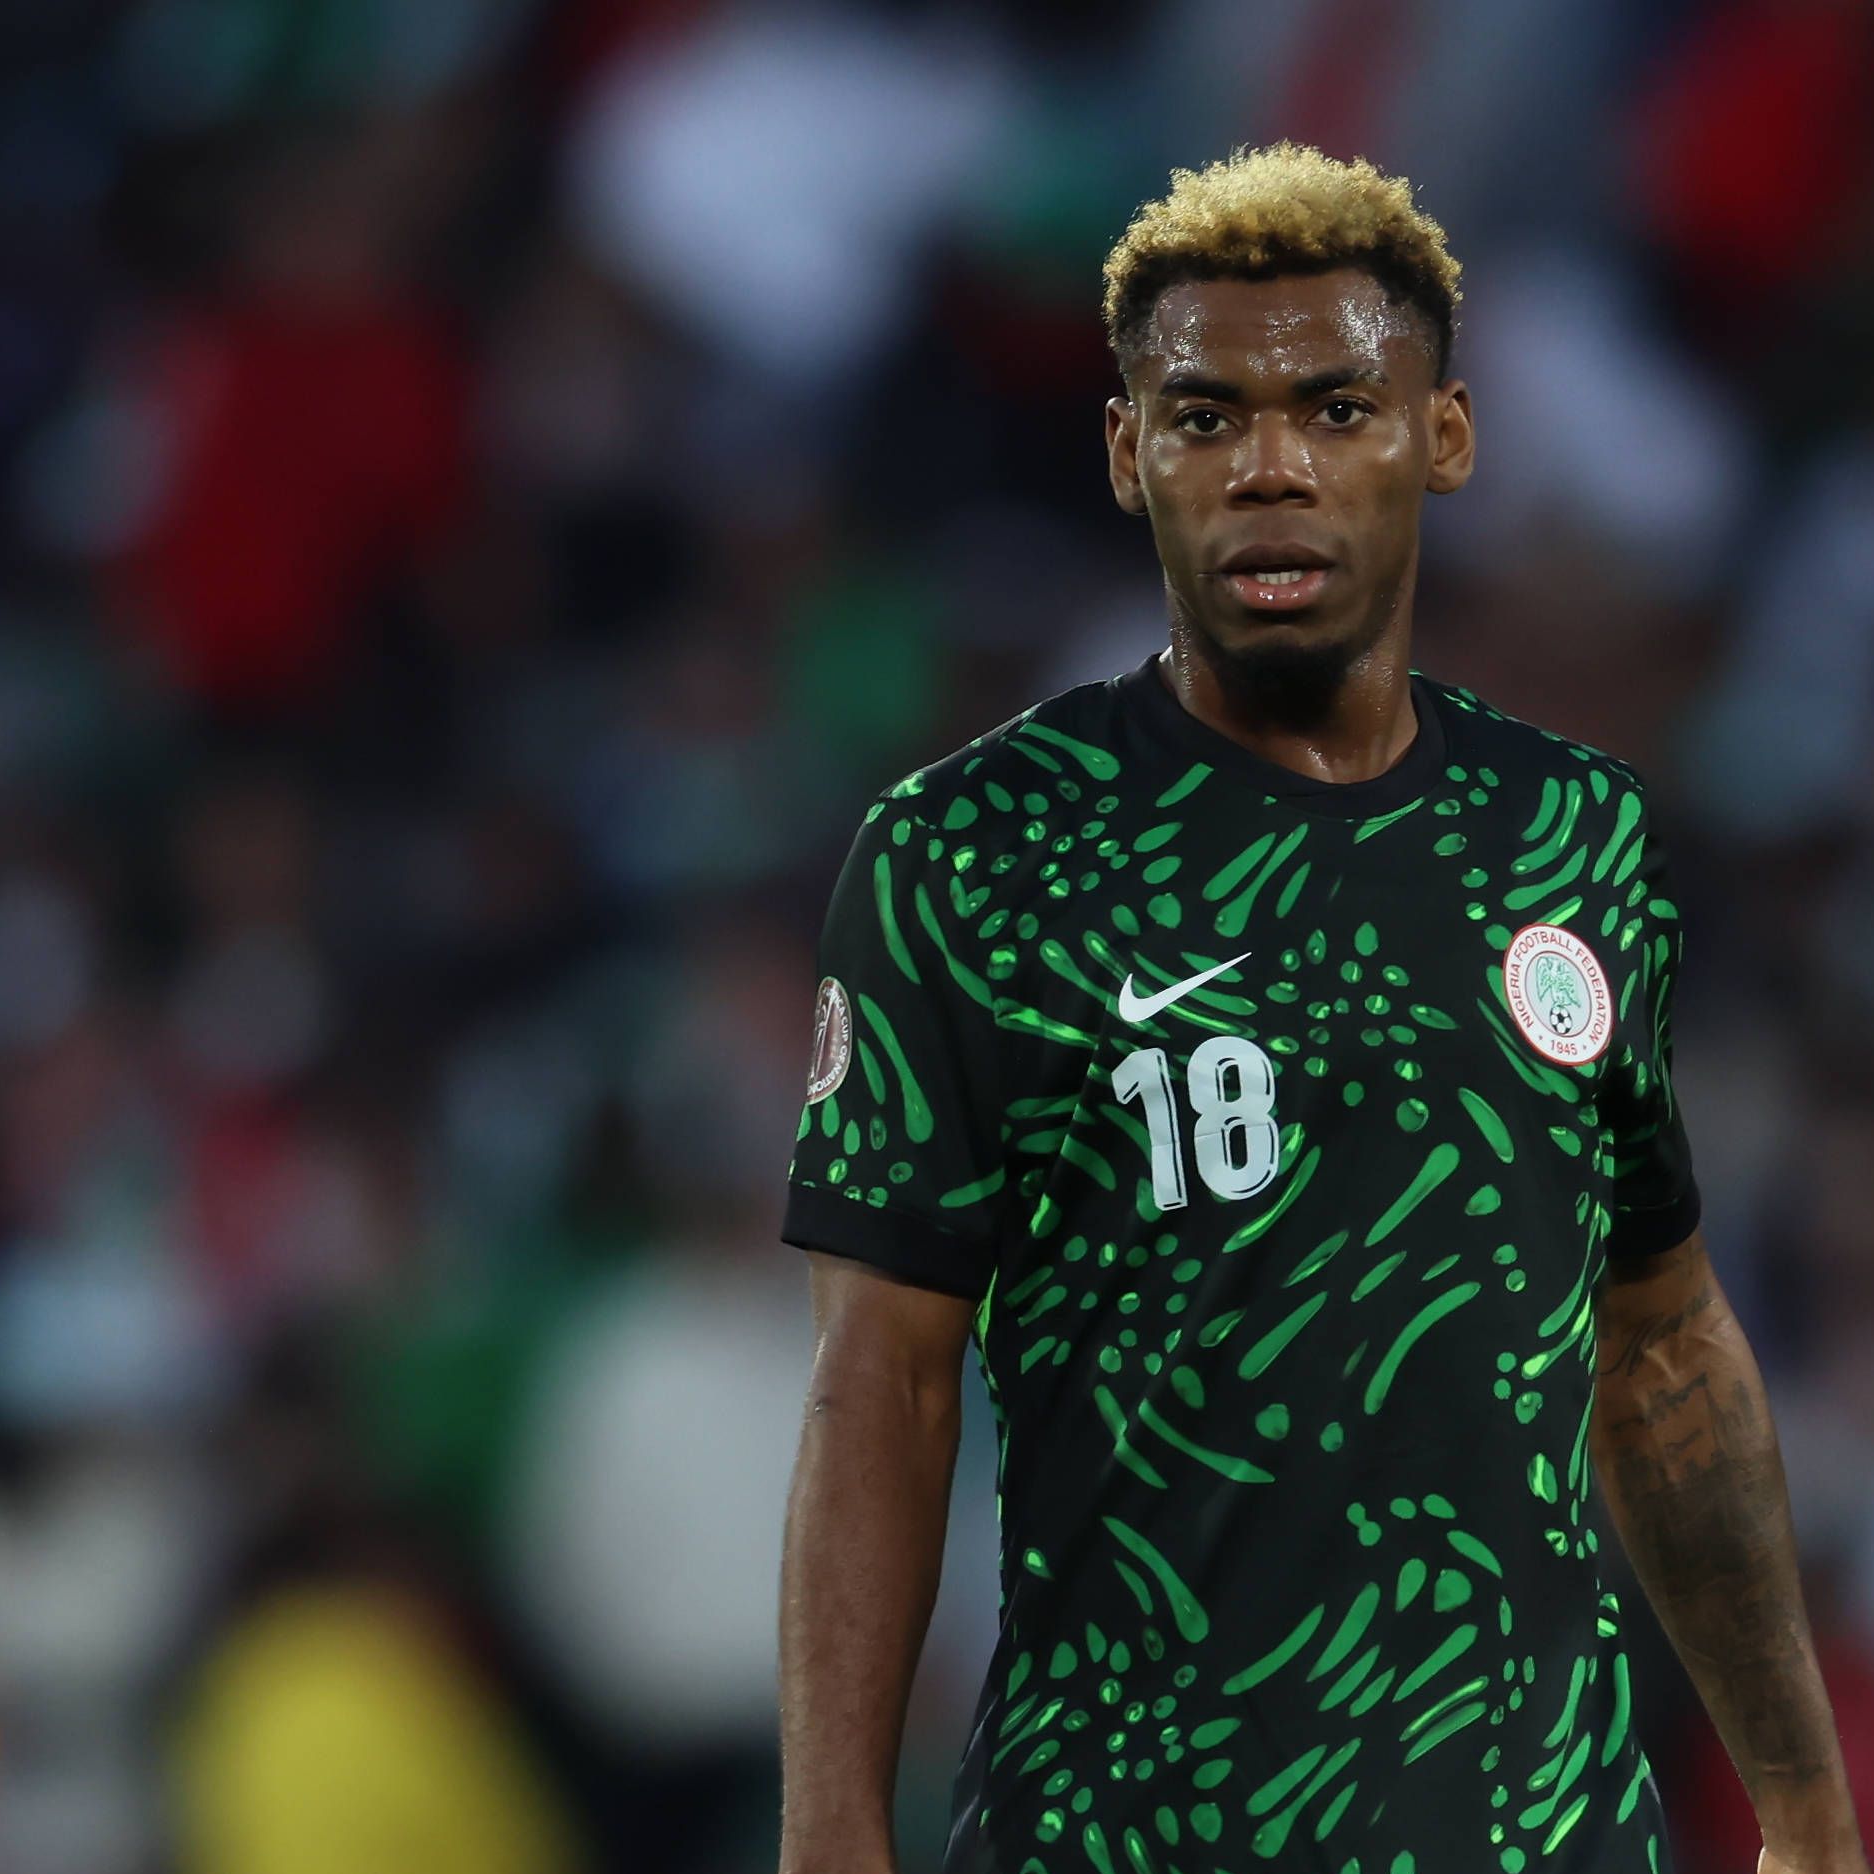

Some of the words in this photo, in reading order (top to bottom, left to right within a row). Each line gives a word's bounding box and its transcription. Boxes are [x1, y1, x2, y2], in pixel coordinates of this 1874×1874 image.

[1514, 931, 1573, 961] FOOTBALL
[1510, 964, 1534, 1028] NIGERIA
[1575, 948, 1607, 1045] FEDERATION
[1550, 1039, 1578, 1055] 1945
[1111, 1036, 1279, 1211] 18
